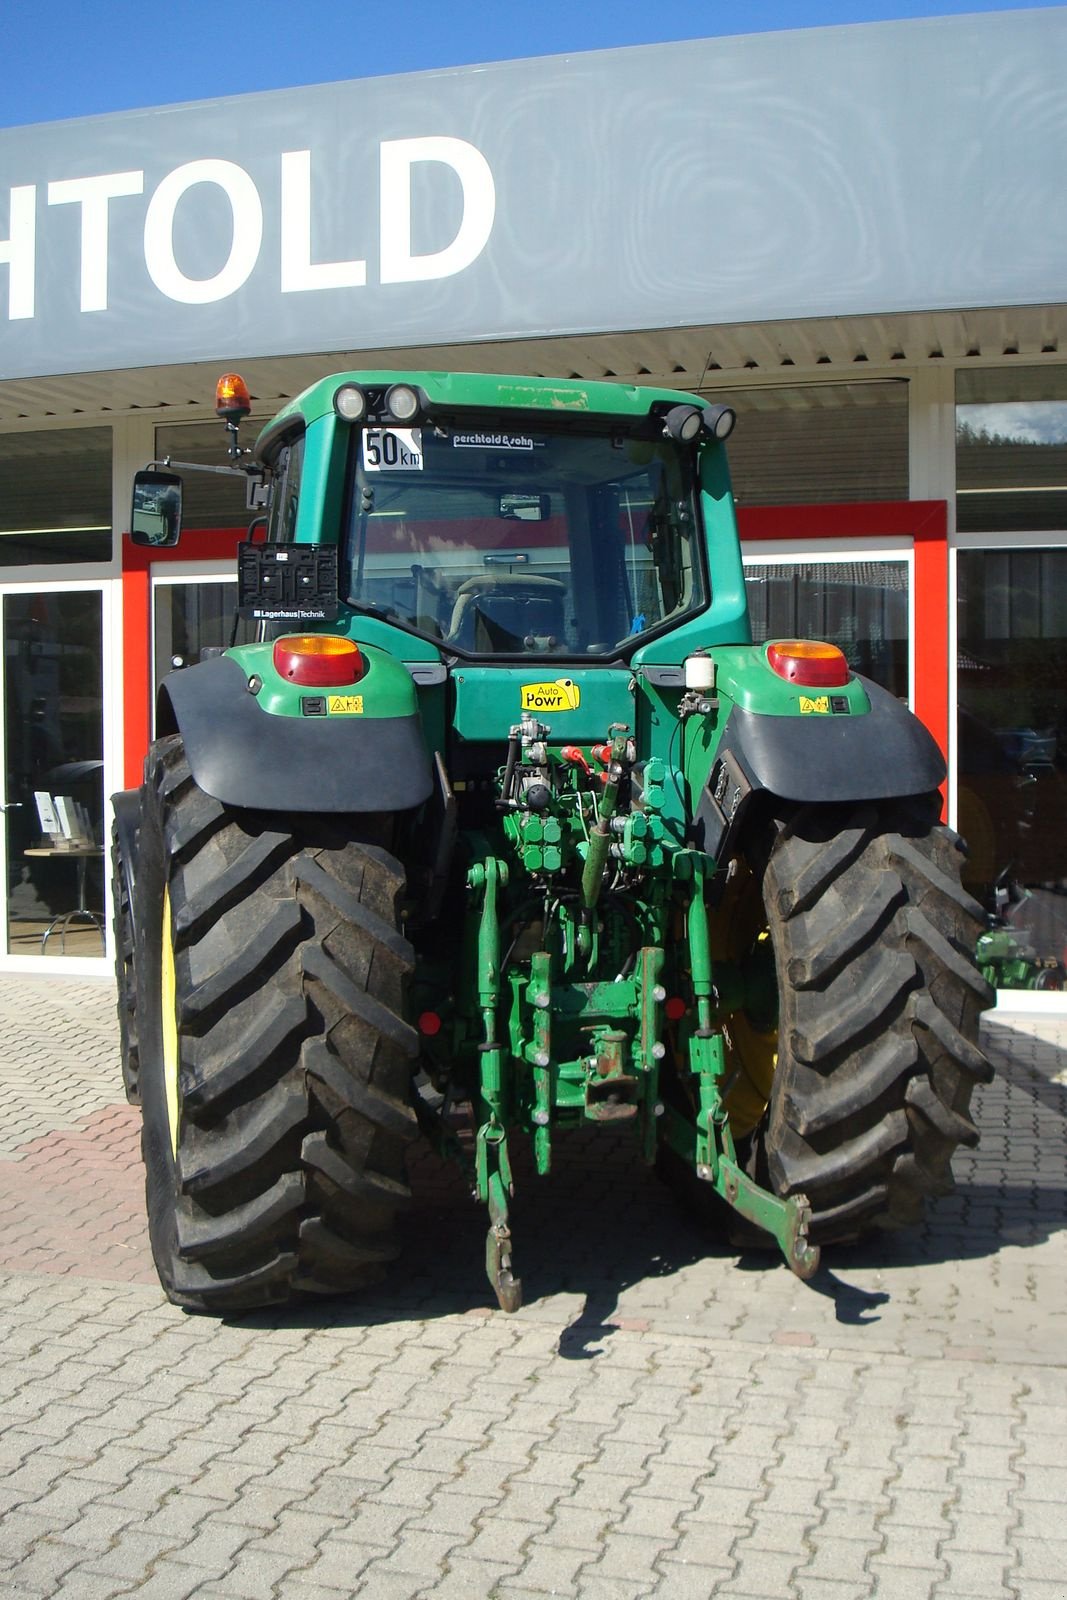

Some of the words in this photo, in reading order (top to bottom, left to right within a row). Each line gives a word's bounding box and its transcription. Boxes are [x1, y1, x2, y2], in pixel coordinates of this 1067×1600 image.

[366, 433, 398, 466] 50
[401, 448, 420, 466] km
[537, 687, 559, 696] Auto
[526, 692, 563, 707] Powr
